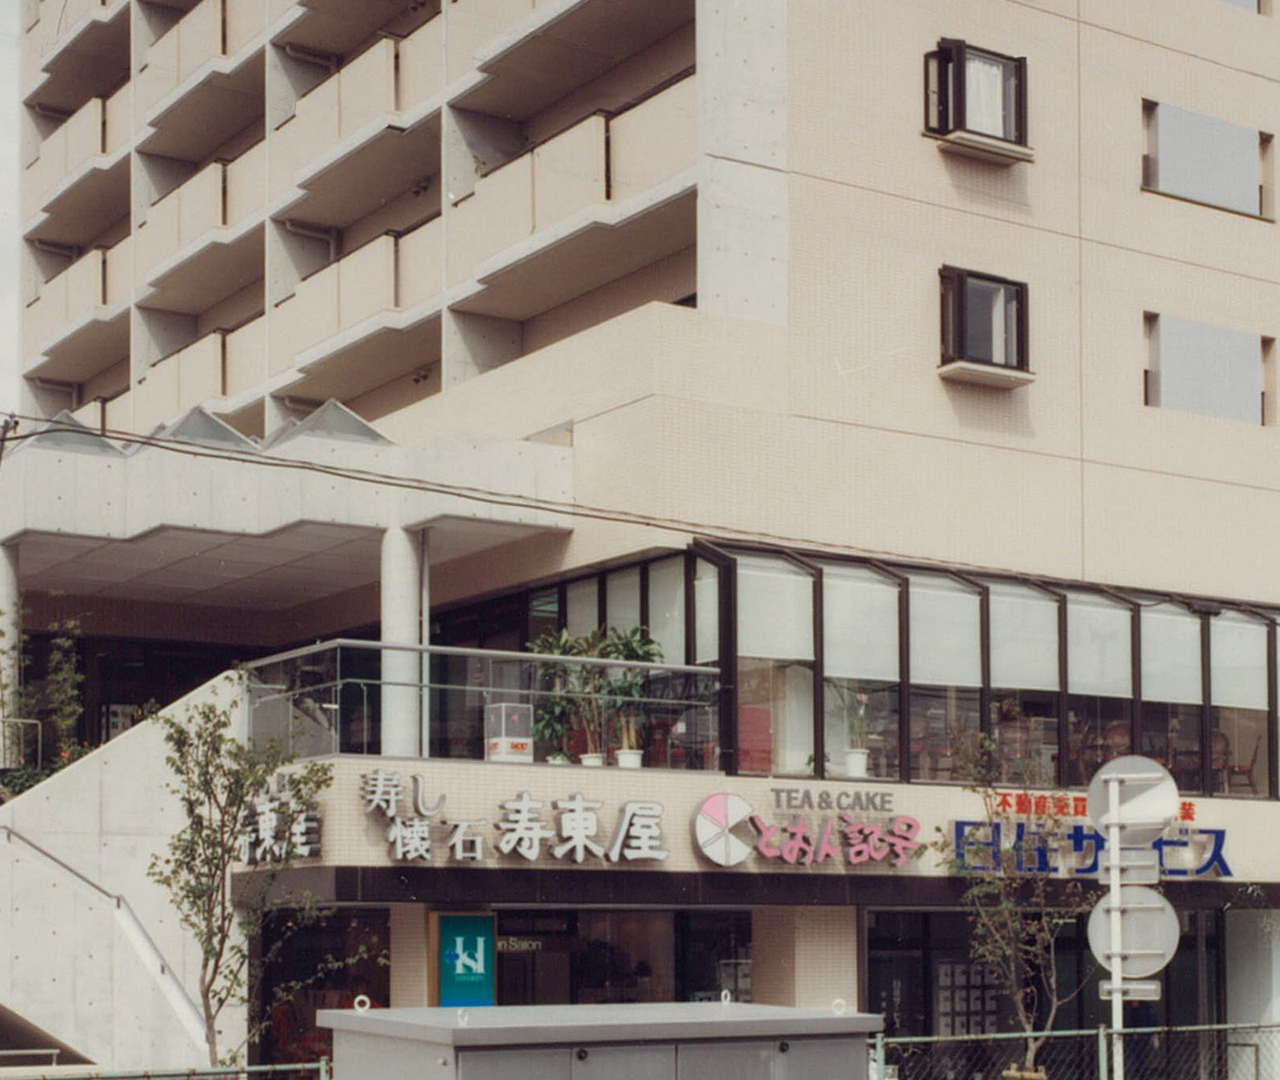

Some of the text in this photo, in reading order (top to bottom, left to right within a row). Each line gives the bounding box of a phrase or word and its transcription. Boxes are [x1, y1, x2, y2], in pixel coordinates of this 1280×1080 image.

[362, 770, 447, 817] 寿し
[771, 788, 893, 812] TEA & CAKE
[389, 817, 487, 861] 懐石
[496, 791, 668, 863] 寿東屋
[752, 812, 921, 868] とおん記号
[955, 821, 1233, 877] 日住サビス
